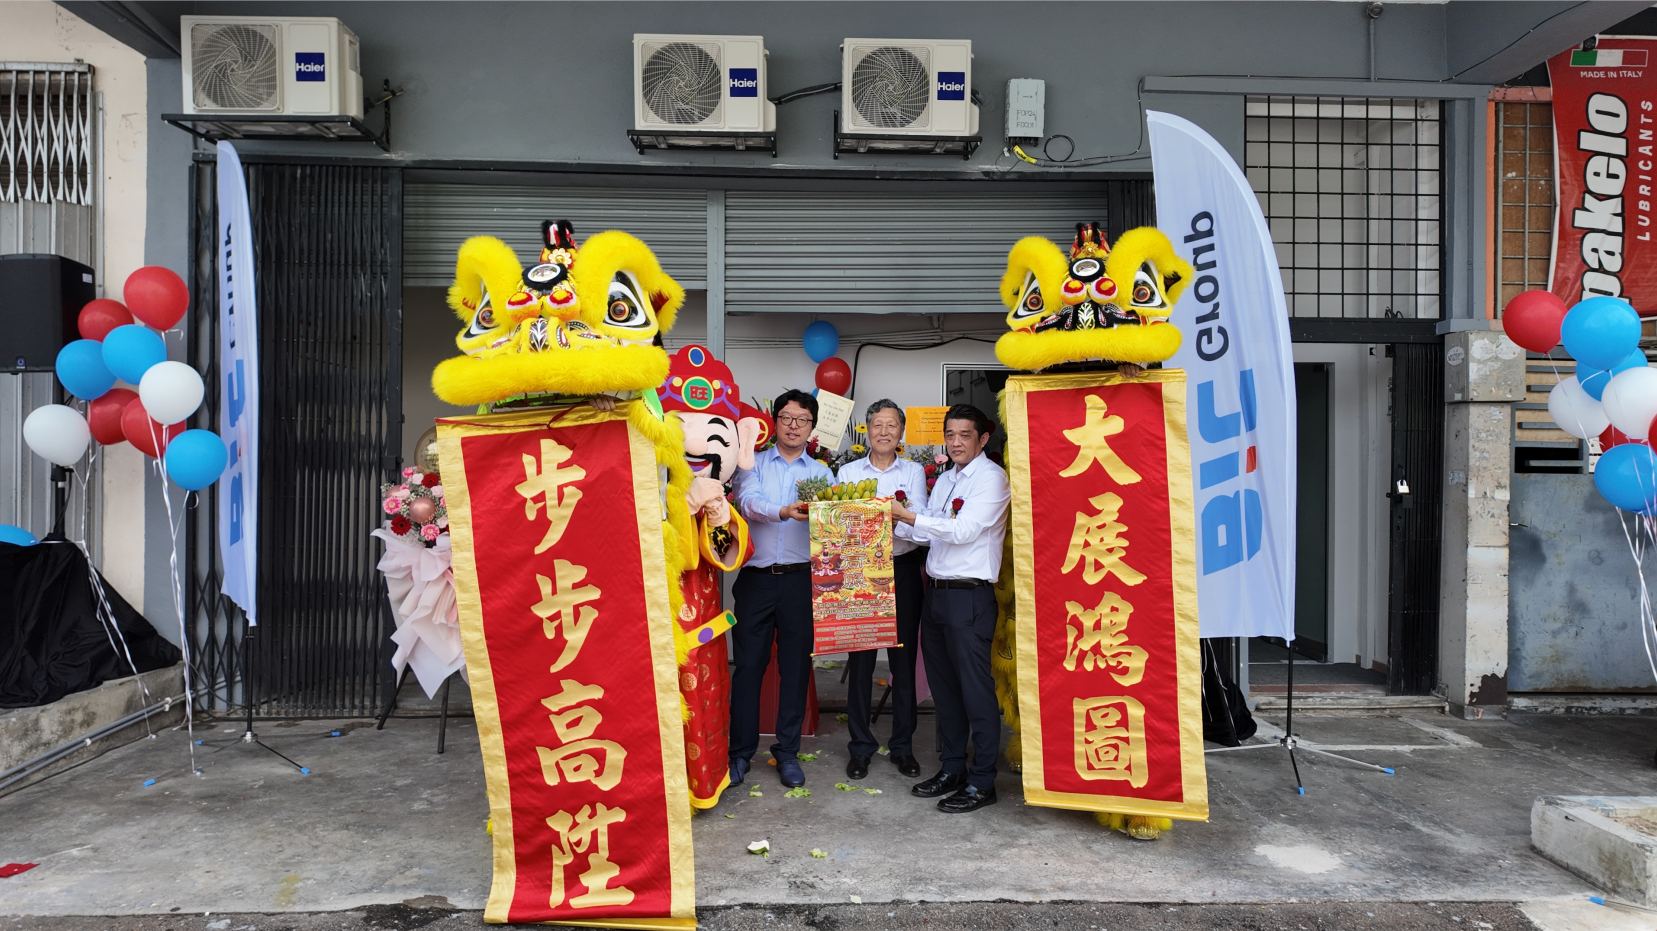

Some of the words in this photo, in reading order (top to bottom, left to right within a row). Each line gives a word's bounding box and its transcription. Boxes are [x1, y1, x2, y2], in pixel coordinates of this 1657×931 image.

[296, 62, 325, 72] Haier
[1580, 70, 1606, 78] MADE
[1619, 70, 1643, 78] ITALY
[730, 78, 757, 88] Haier
[937, 81, 965, 91] Haier
[1636, 100, 1653, 241] LUBRICANTS
[689, 385, 710, 401] 旺
[838, 512, 868, 589] 福星高照
[1058, 393, 1149, 789] 大展鴻圖
[515, 438, 636, 909] 步步高陞
